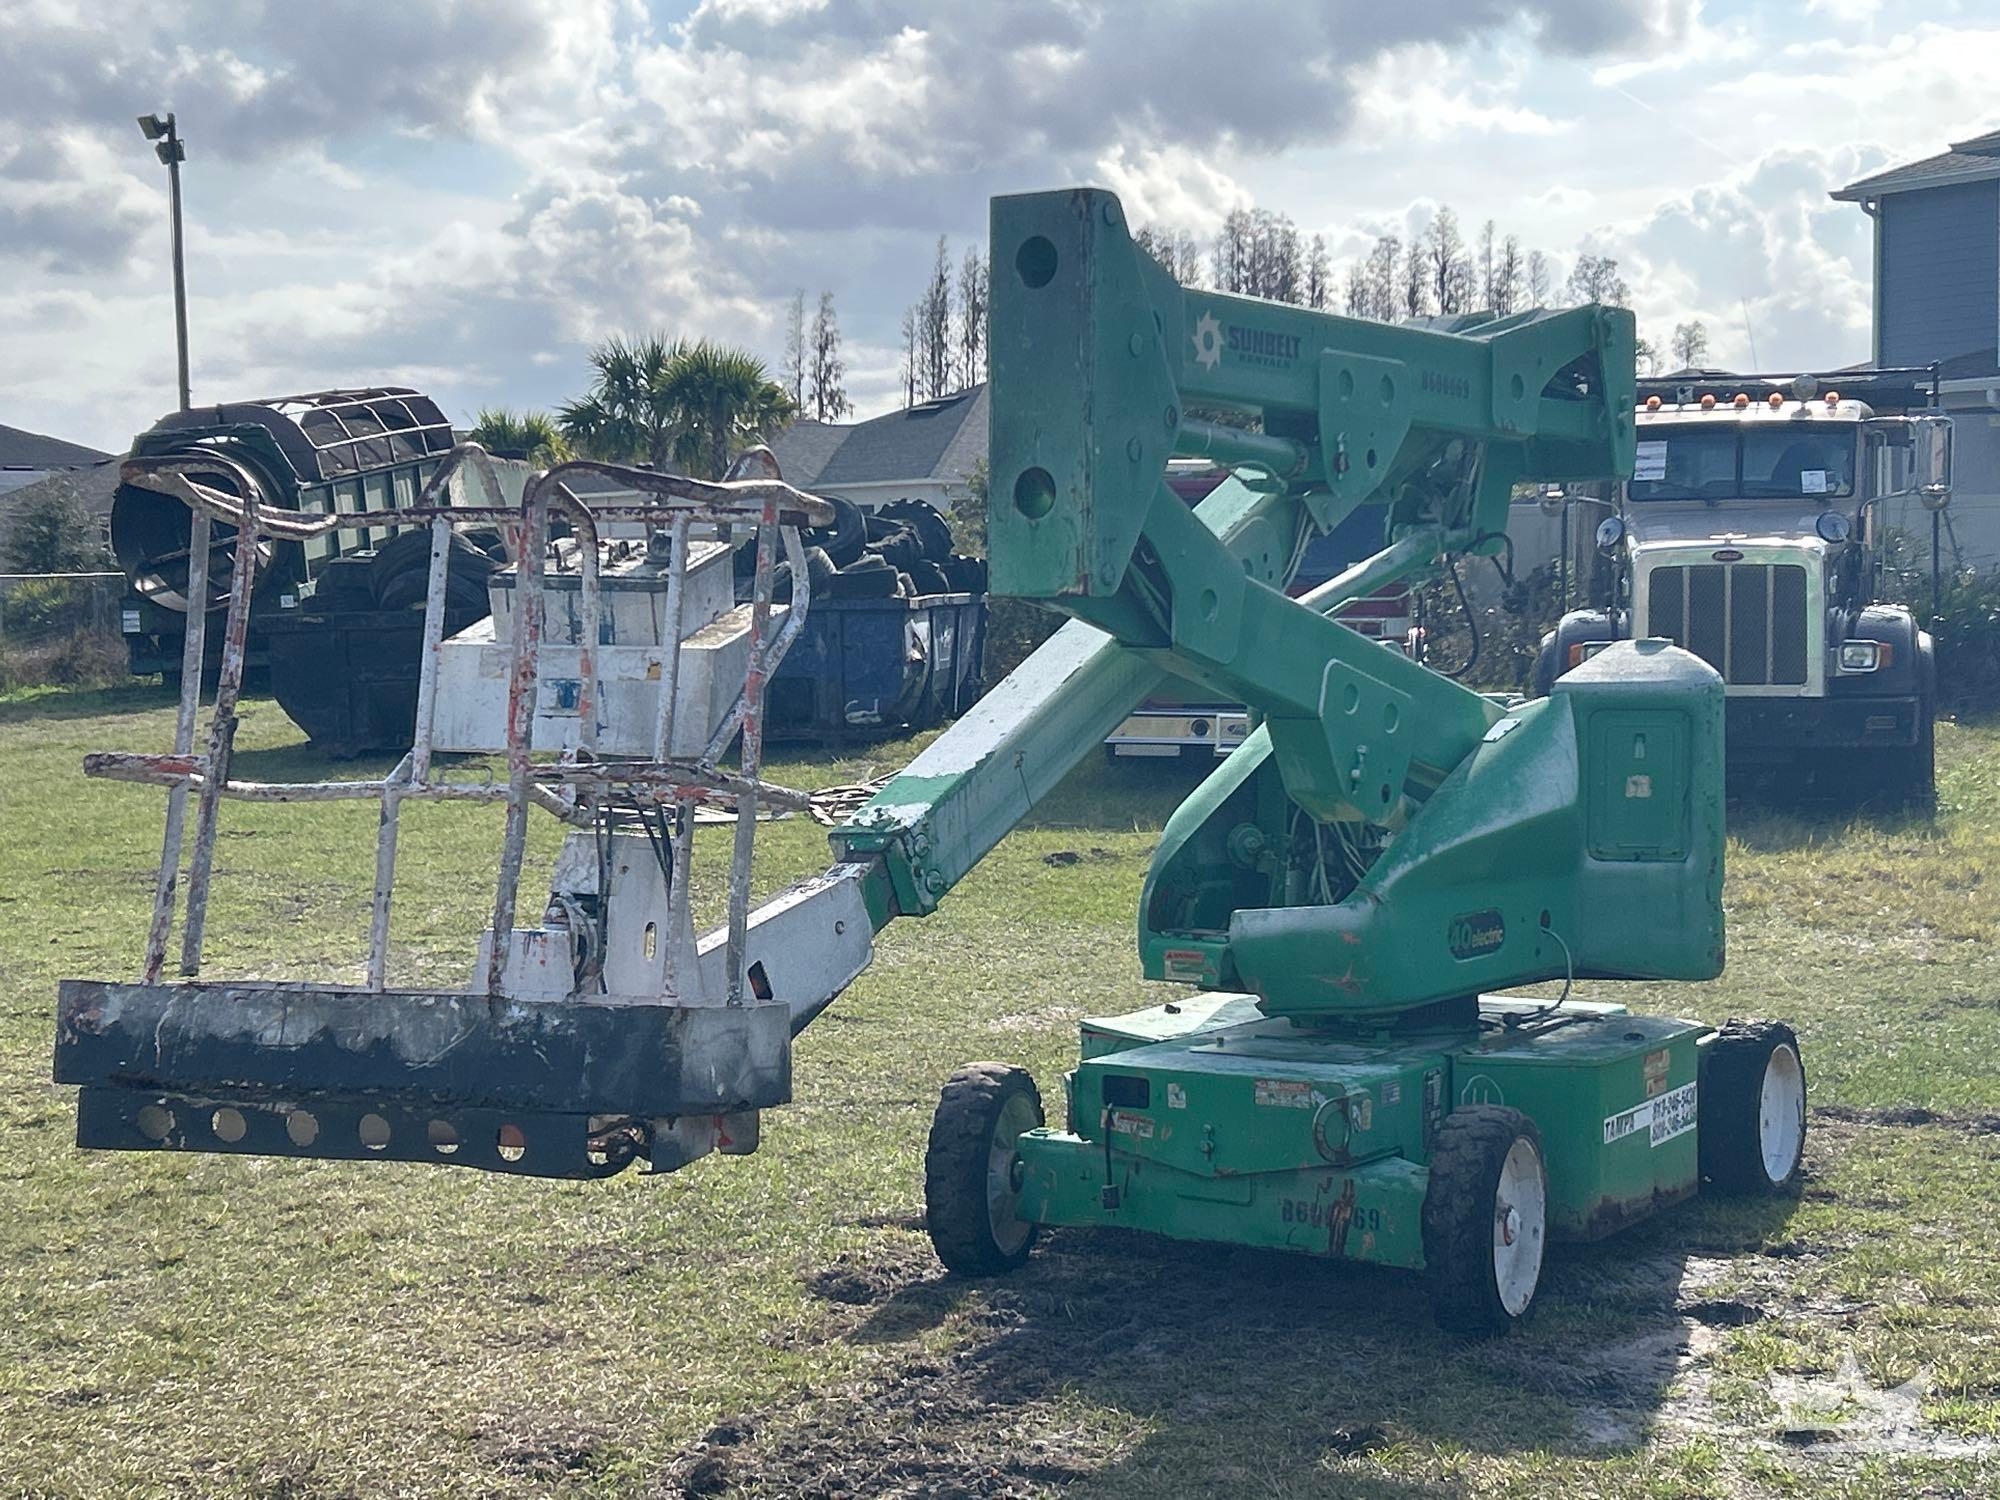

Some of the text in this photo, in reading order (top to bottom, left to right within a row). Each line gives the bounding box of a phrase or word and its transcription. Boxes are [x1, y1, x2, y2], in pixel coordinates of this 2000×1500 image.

[1227, 324, 1302, 360] SUNBELT
[1472, 924, 1504, 949] electric
[1604, 1112, 1635, 1142] TAMPA
